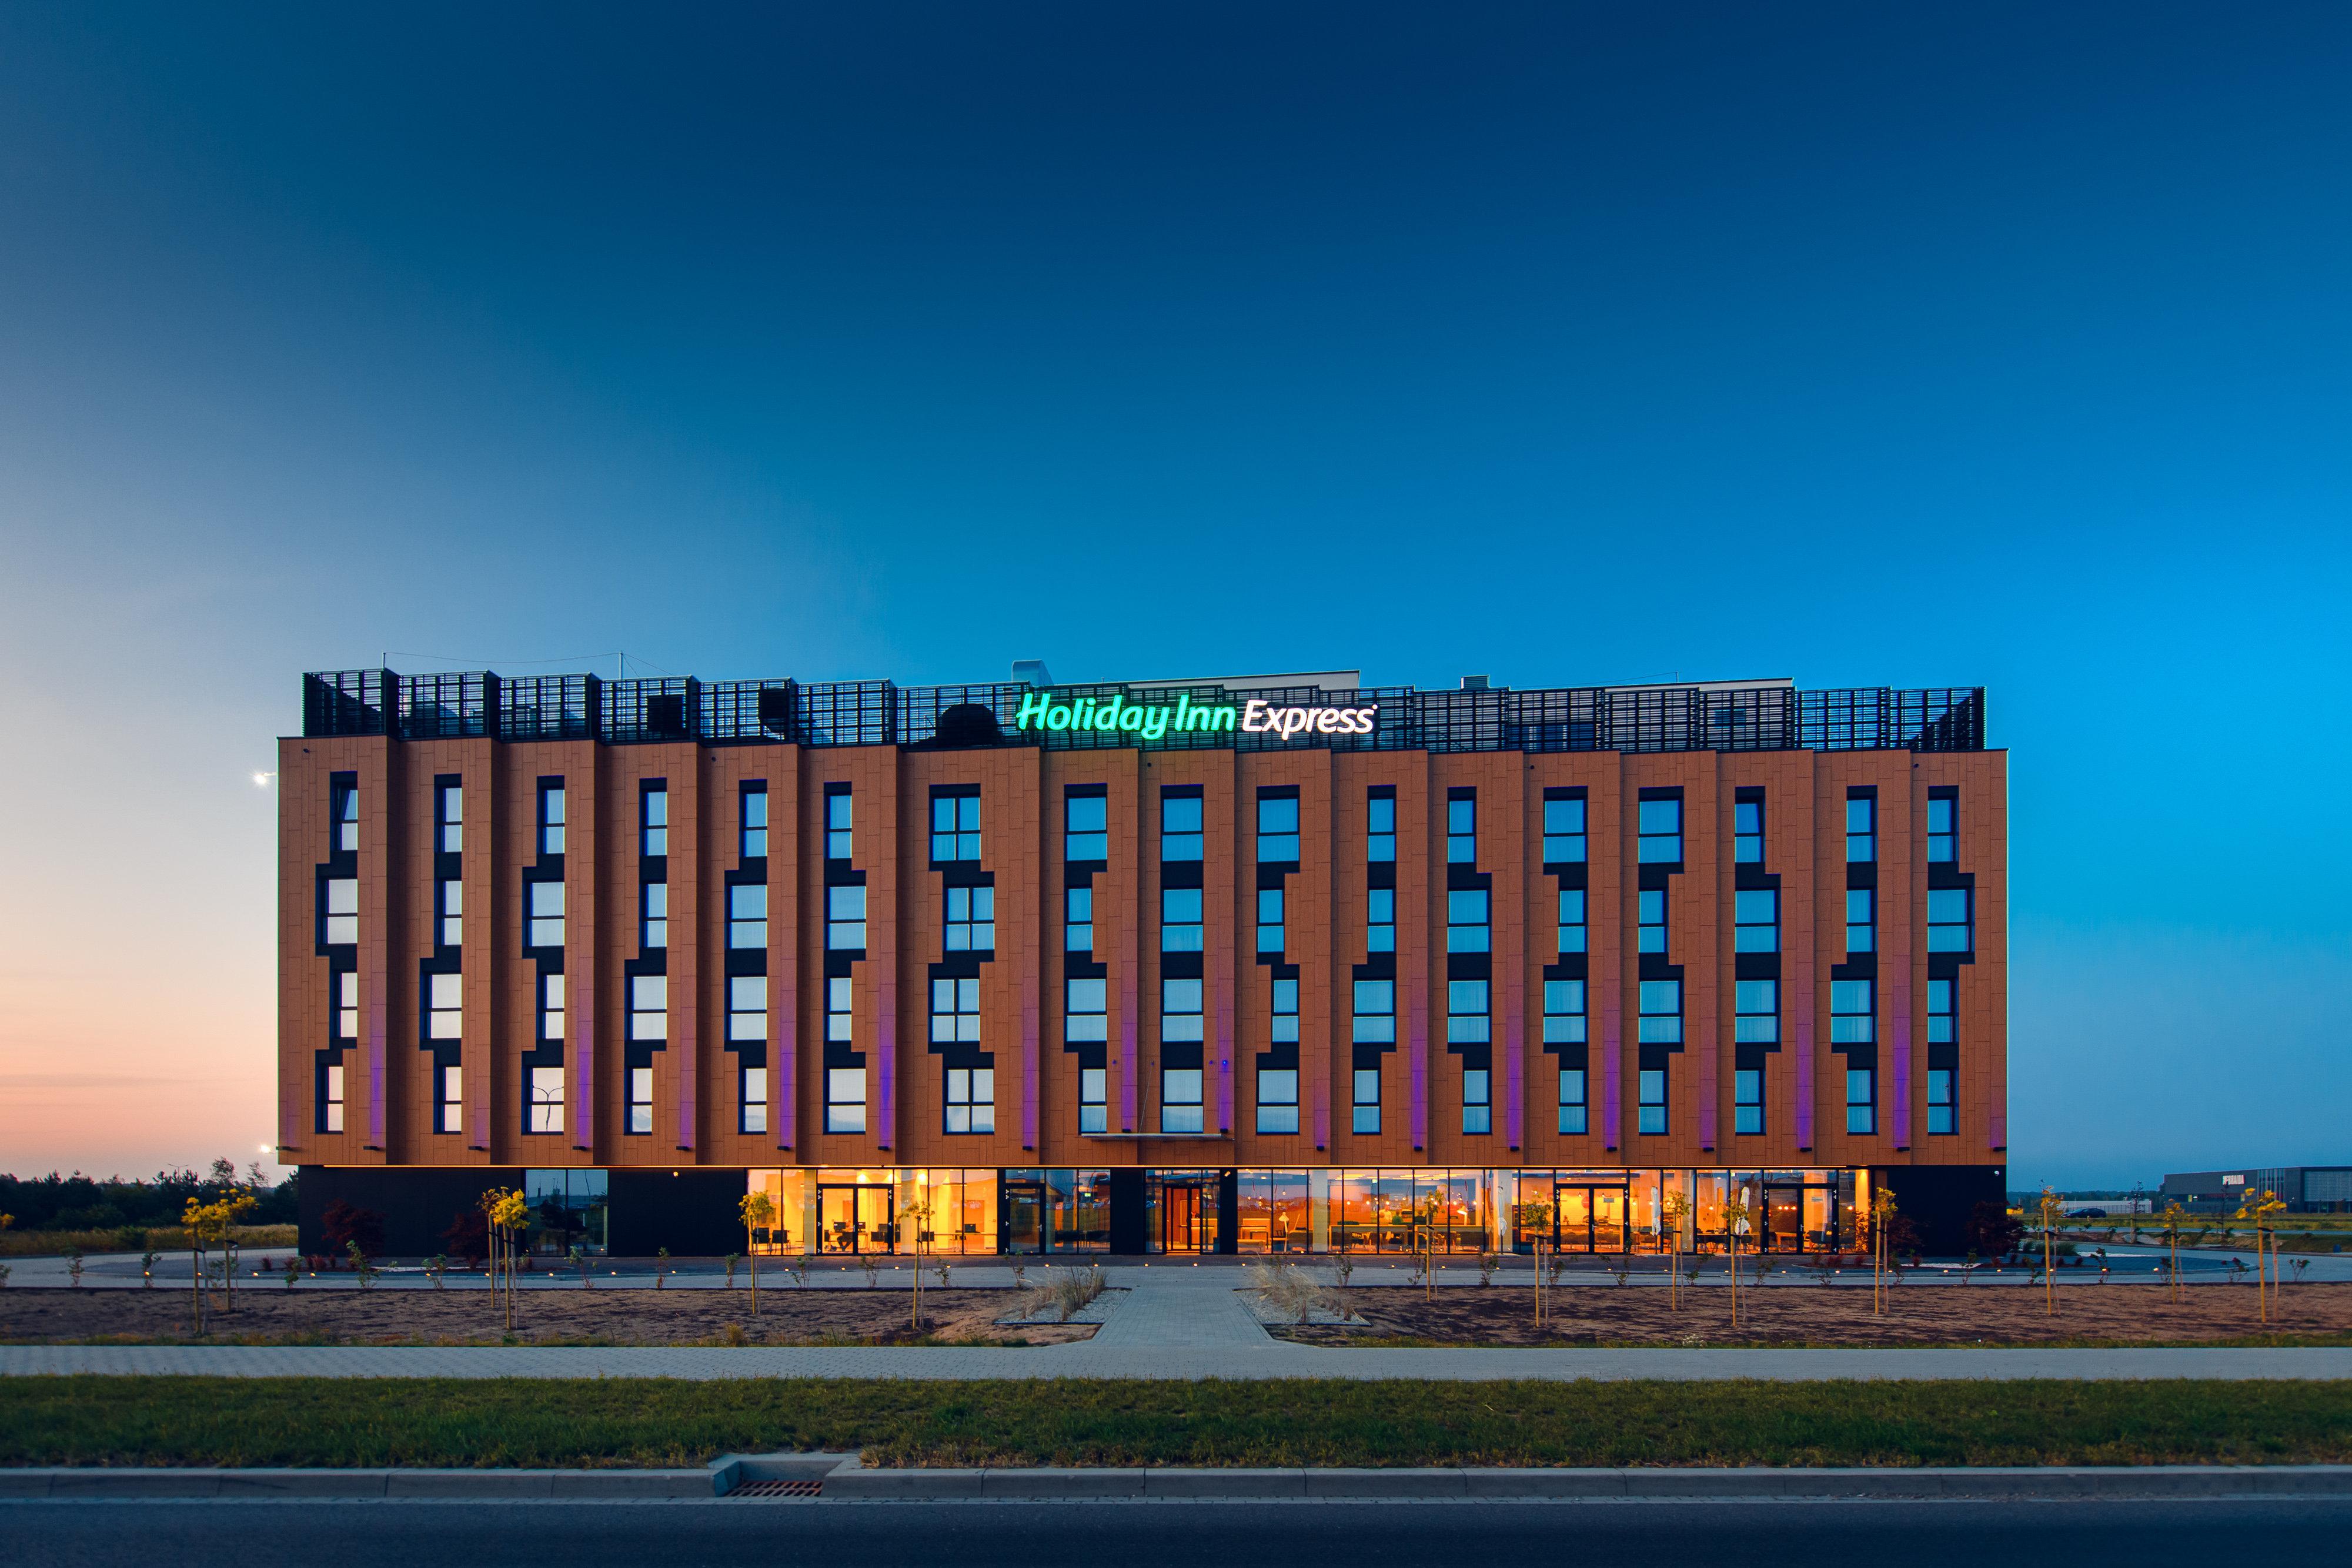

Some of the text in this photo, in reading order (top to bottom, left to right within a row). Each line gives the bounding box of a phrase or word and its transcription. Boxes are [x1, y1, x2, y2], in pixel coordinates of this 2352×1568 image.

[1017, 693, 1376, 740] Holiday Inn Express
